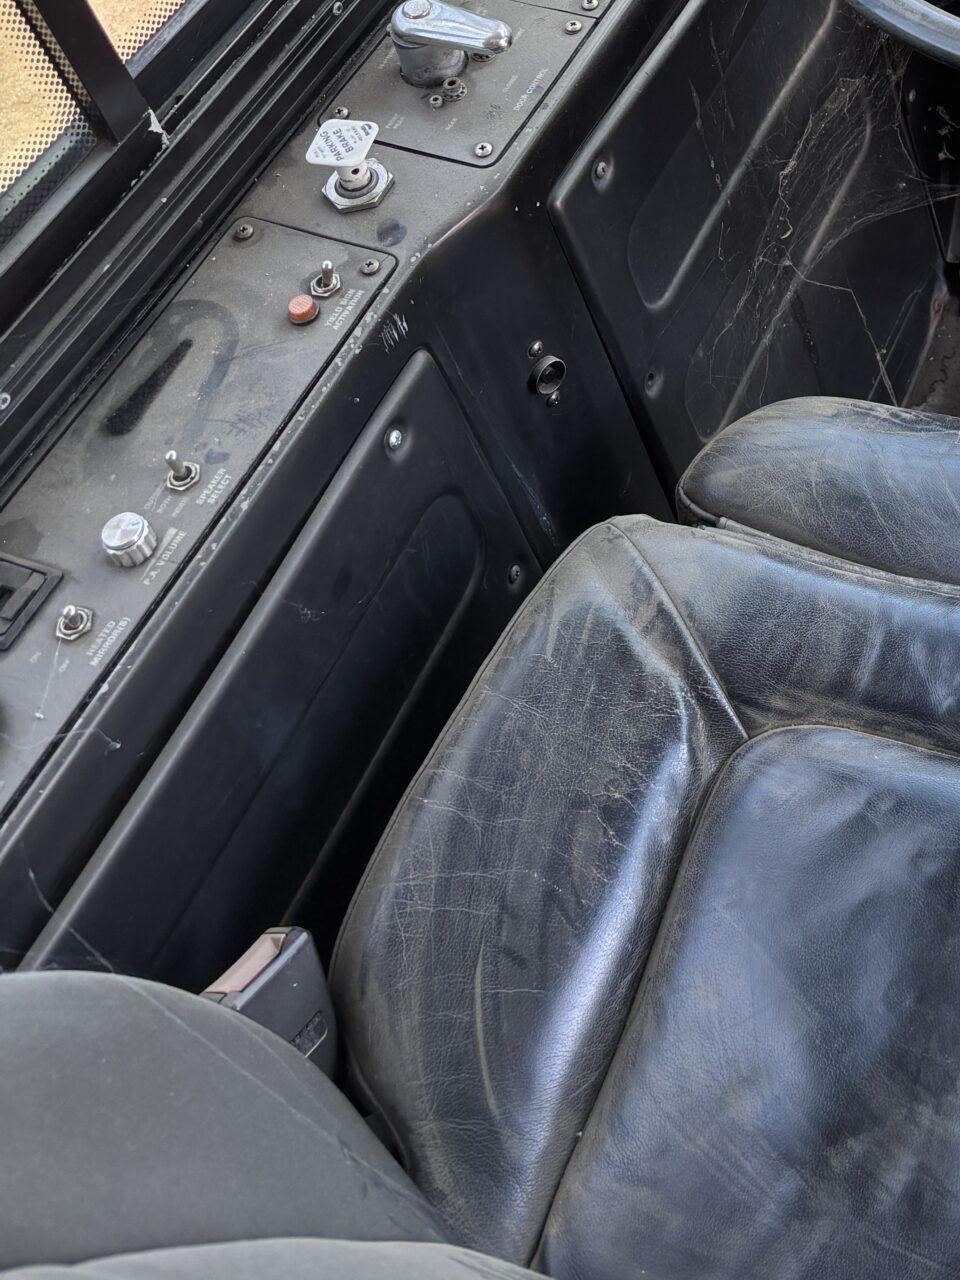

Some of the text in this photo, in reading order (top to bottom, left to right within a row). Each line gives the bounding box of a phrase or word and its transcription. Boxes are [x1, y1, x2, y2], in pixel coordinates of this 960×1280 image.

[320, 130, 345, 162] PARKING
[332, 128, 355, 153] BRAKE
[324, 305, 343, 327] YIELD
[332, 289, 365, 331] ACTIVATION
[196, 468, 227, 505] SPEAKER
[206, 474, 232, 504] SELECT
[157, 529, 188, 566] VOLUME
[86, 620, 116, 656] HEATED
[89, 616, 131, 667] MIRROR(S)
